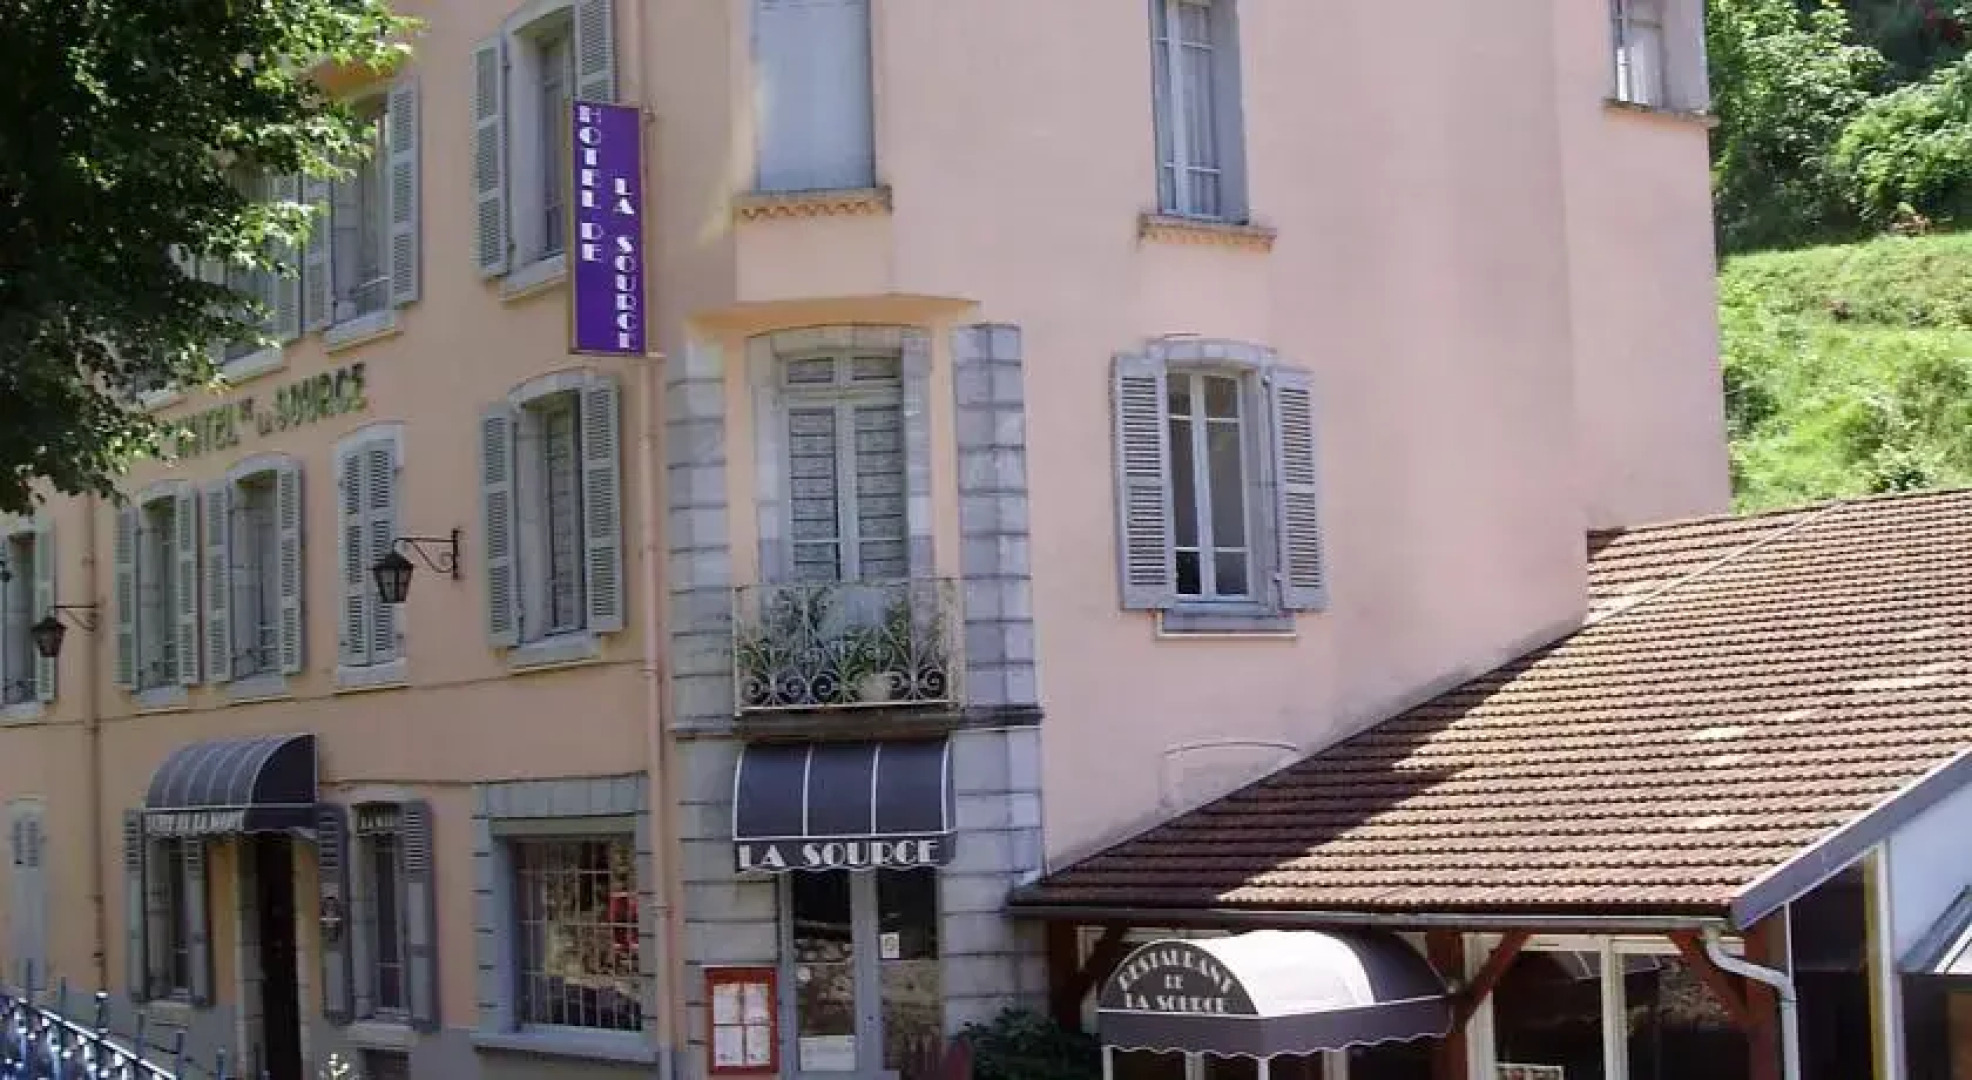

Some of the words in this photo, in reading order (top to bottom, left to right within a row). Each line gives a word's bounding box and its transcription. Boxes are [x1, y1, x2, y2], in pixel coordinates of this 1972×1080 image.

[579, 104, 603, 209] HOTEL
[613, 177, 634, 215] LA
[581, 222, 604, 262] DE
[614, 235, 637, 349] SOURCE
[738, 845, 785, 867] LA
[802, 840, 940, 865] SOURCE
